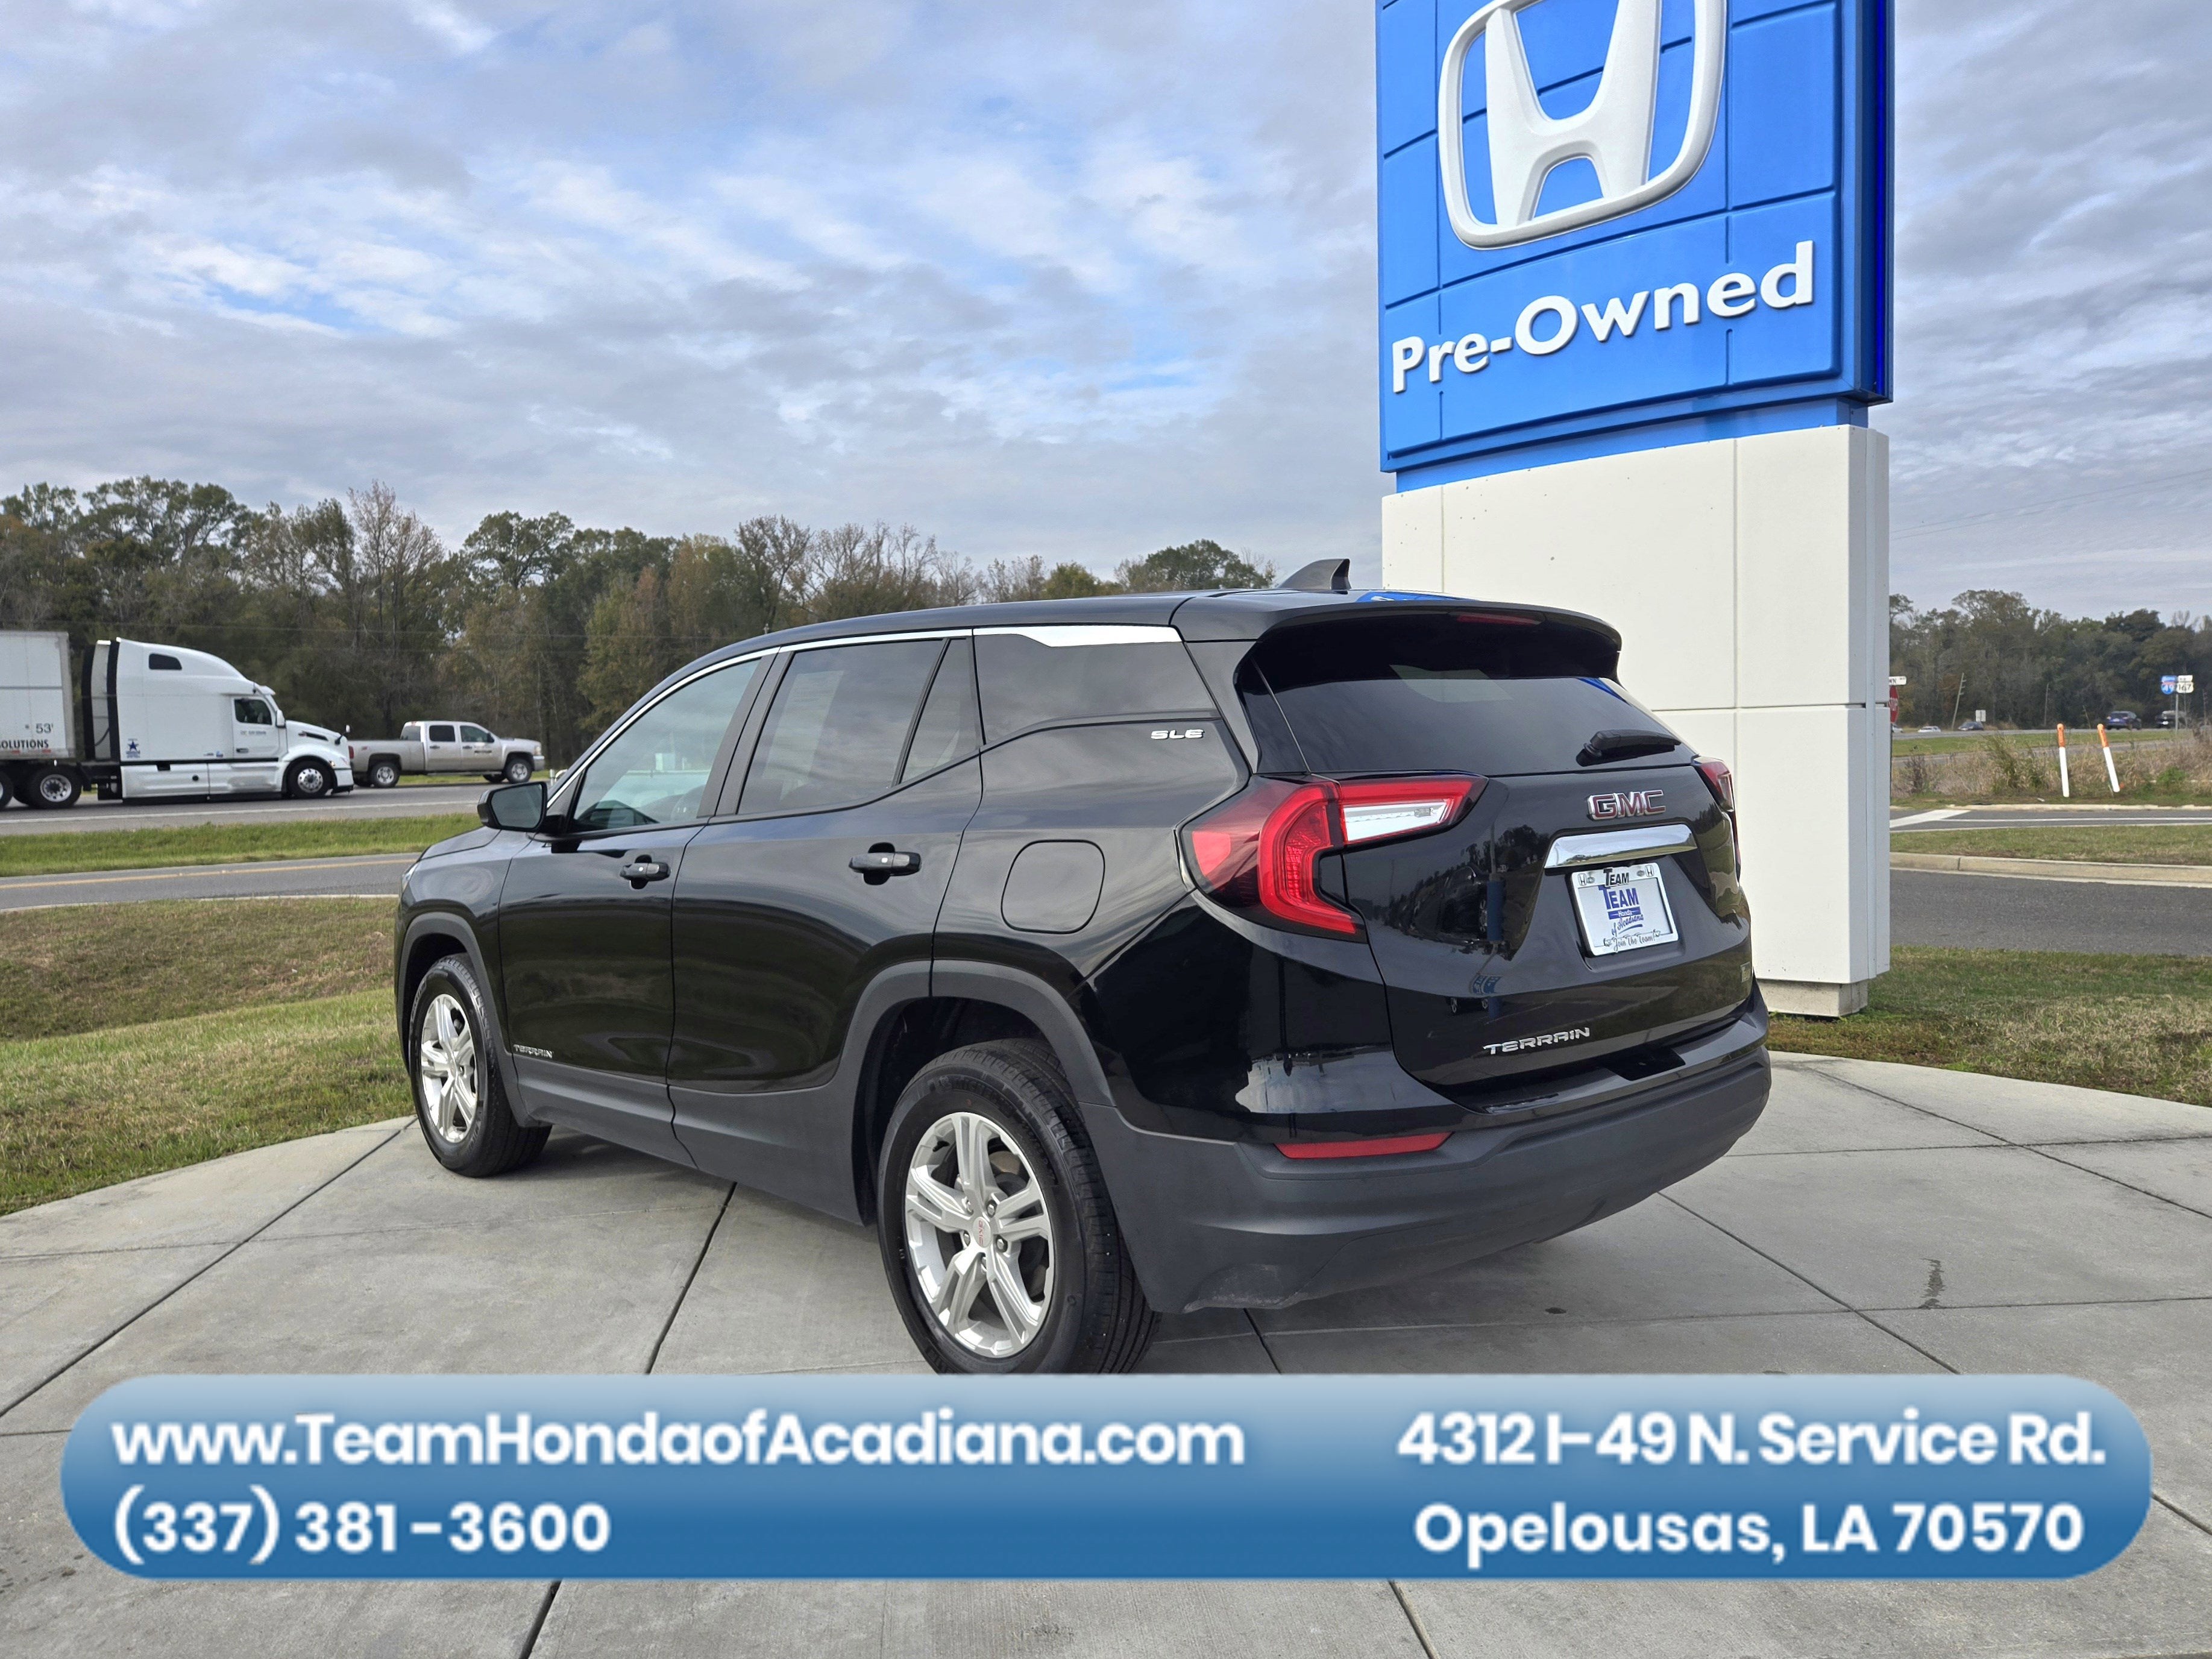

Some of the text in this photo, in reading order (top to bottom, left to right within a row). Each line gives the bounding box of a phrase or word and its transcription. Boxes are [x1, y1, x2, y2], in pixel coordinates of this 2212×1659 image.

[1392, 240, 1813, 393] Pre-Owned
[0, 740, 49, 748] OLUTIONS
[1150, 729, 1204, 740] SLE
[1588, 789, 1667, 820] GMC
[1603, 869, 1629, 886] TEAM
[1598, 884, 1639, 910] TEAM
[513, 1044, 553, 1059] TERRAIN
[1483, 1027, 1590, 1055] TERRAIN
